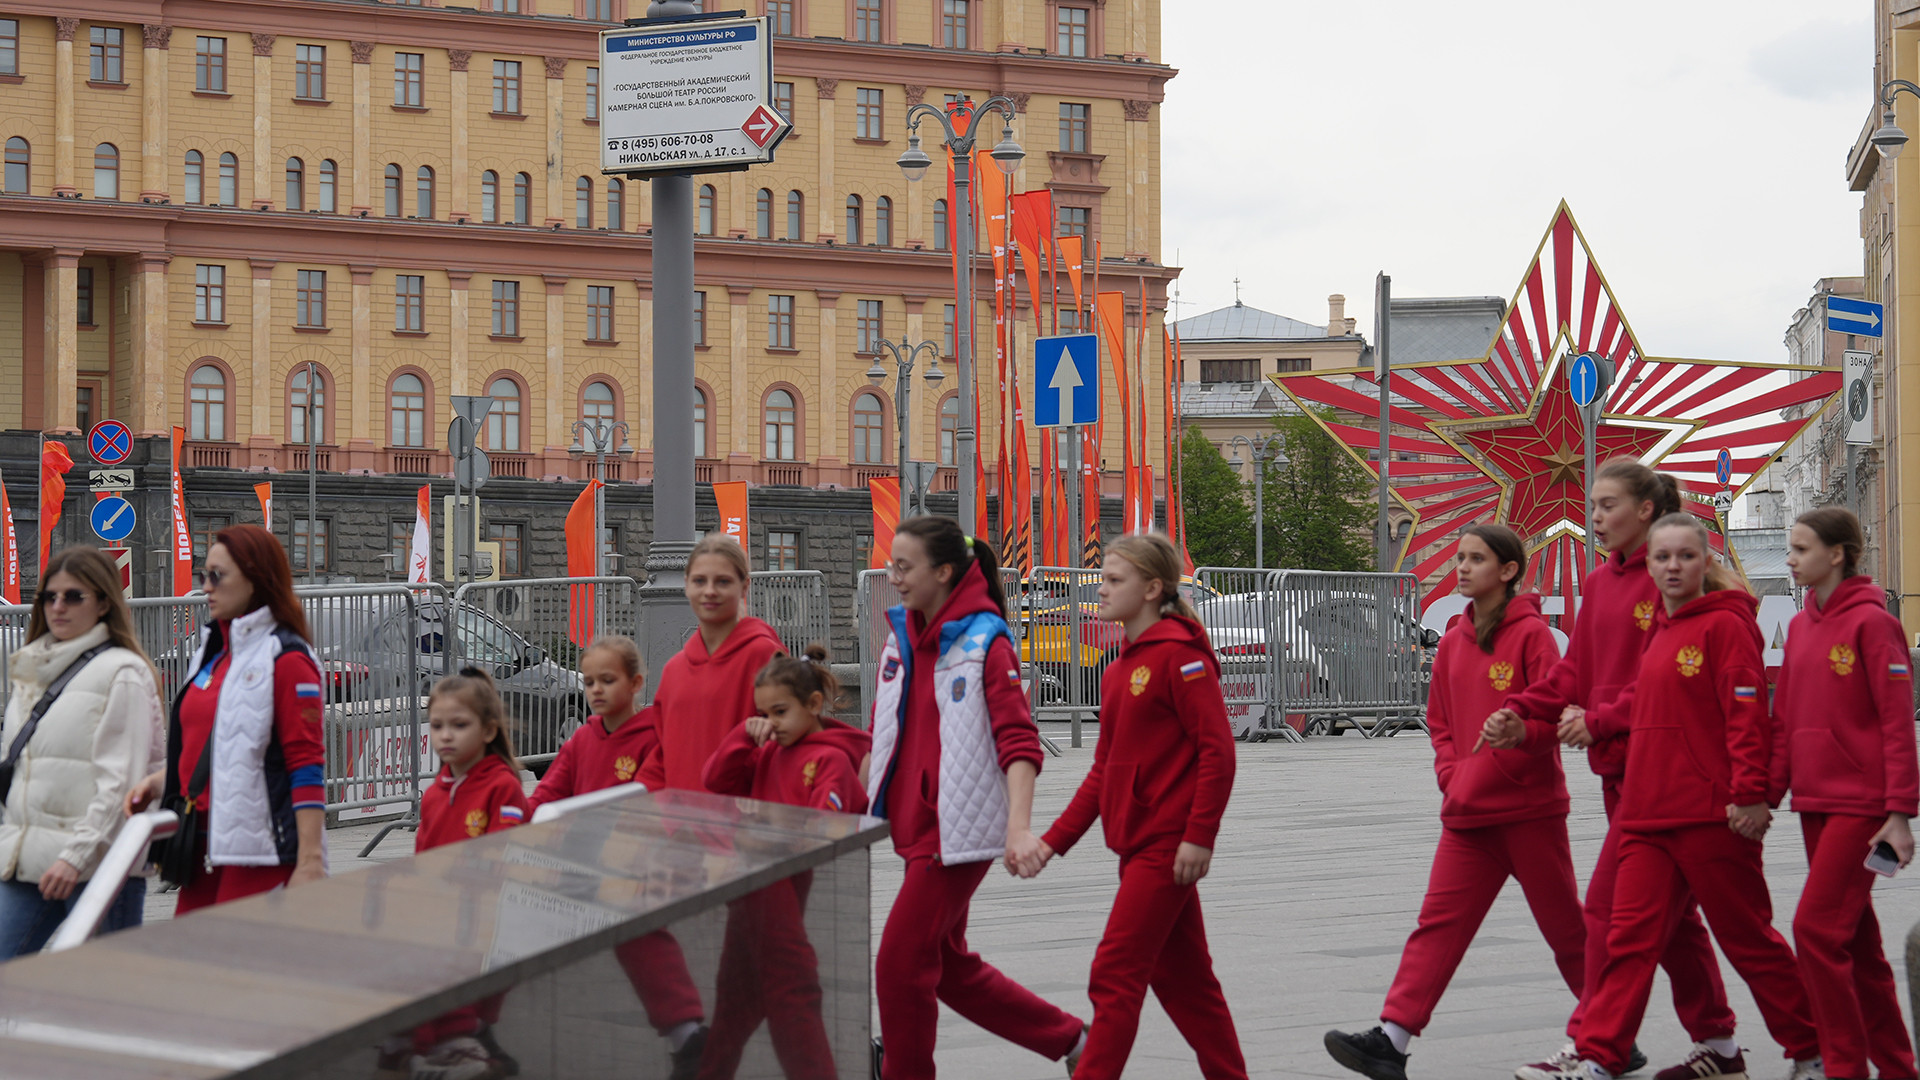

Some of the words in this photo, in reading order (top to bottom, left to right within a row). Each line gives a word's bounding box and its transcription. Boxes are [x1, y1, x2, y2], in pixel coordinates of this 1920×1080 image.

[627, 35, 686, 47] МИНИСТЕРСТВО
[686, 31, 724, 42] КУЛЬТУРЫ
[620, 51, 658, 61] ФЕДЕРАЛЬНОЕ
[658, 47, 708, 58] ГОСУДАРСТВЕННОЕ
[709, 44, 743, 53] БЮДЖЕТНОЕ
[649, 57, 685, 65] УЧРЕЖДЕНИЕ
[685, 54, 713, 62] КУЛЬТУРЫ
[687, 72, 750, 85] АКАДЕМИЧЕСКИЙ
[636, 89, 674, 101] БОЛЬШОЙ
[674, 88, 696, 97] ТЕАТР
[697, 86, 727, 96] РОССИИ
[607, 103, 648, 113] КАМЕРНАЯ
[648, 100, 673, 110] СЦЕНА
[621, 140, 629, 150] 8
[630, 138, 658, 151] (495)
[660, 133, 714, 147] 606-70-08
[619, 150, 687, 163] НИКОЛЬСКАЯ
[704, 149, 713, 158] д.
[741, 147, 747, 155] 1
[1850, 356, 1867, 367] ЗОНА
